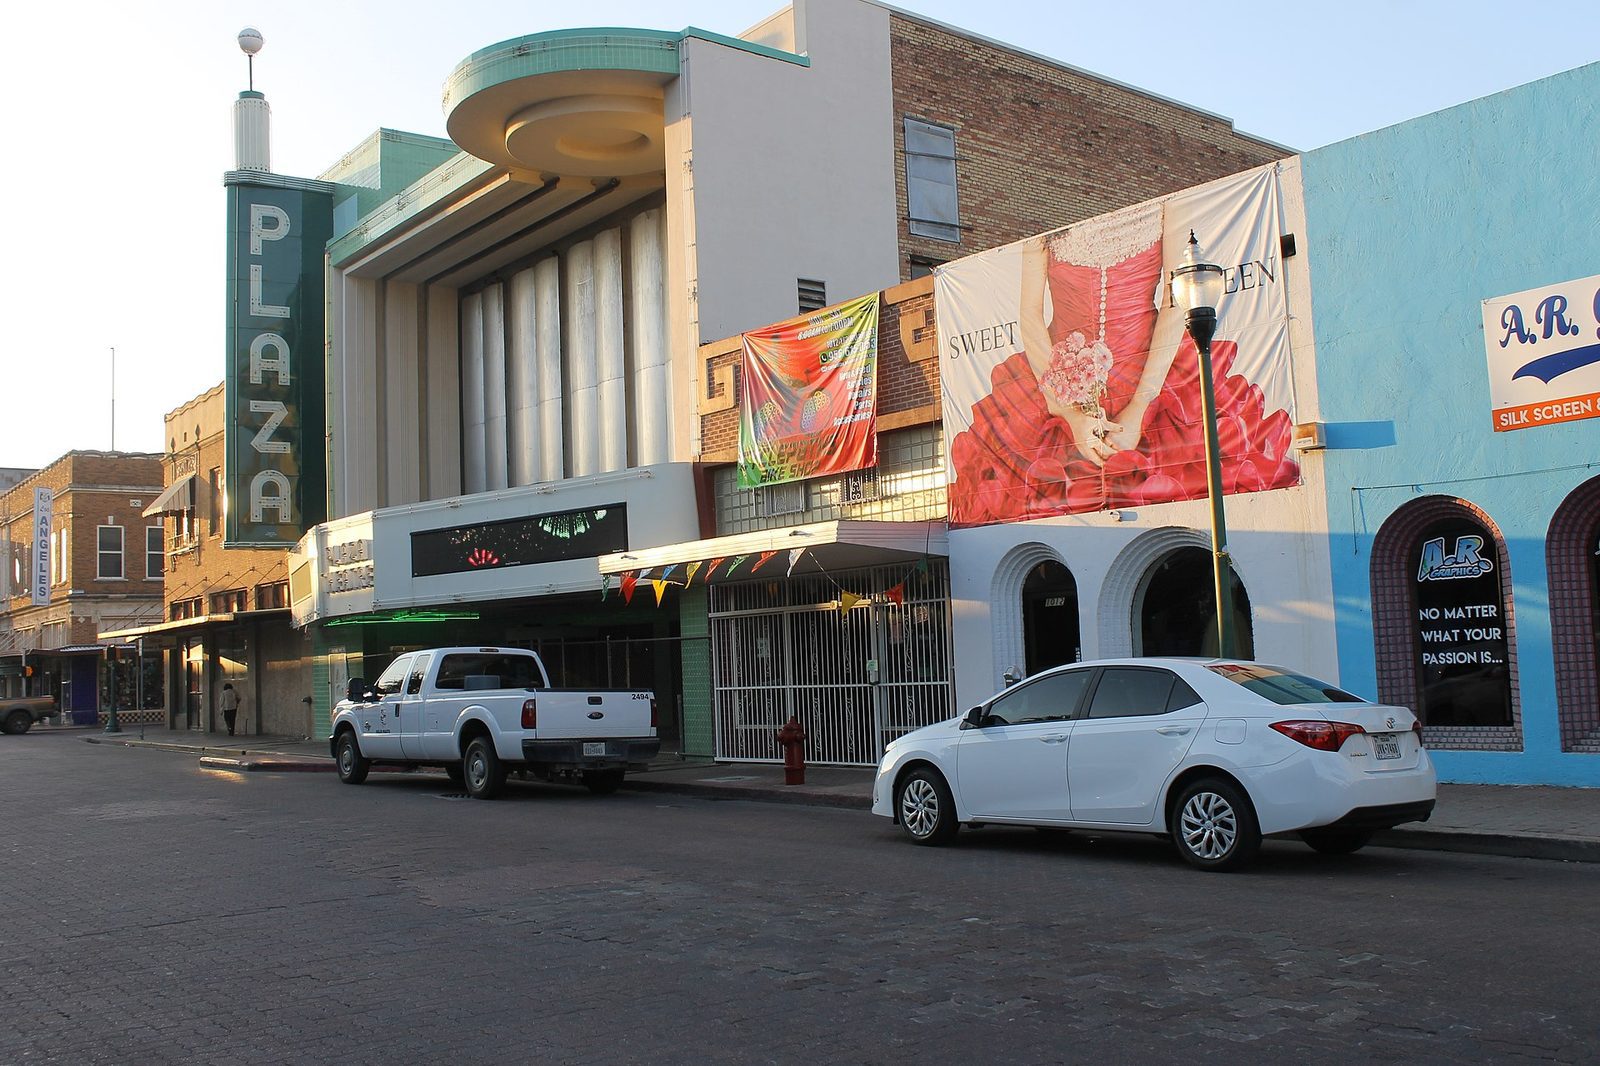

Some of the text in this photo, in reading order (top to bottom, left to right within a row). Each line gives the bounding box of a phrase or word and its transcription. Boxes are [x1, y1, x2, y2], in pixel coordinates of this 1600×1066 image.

[949, 320, 1018, 360] SWEET
[249, 203, 291, 523] PLAZA
[854, 400, 872, 411] Parts
[1500, 409, 1530, 427] SILK
[1533, 399, 1592, 422] SCREEN
[38, 515, 49, 598] ANGELES
[1430, 566, 1481, 578] GRAPHICS
[1419, 604, 1498, 621] NO MATTER
[1421, 627, 1502, 642] WHAT YOUR
[1422, 650, 1504, 665] PASSION IS...
